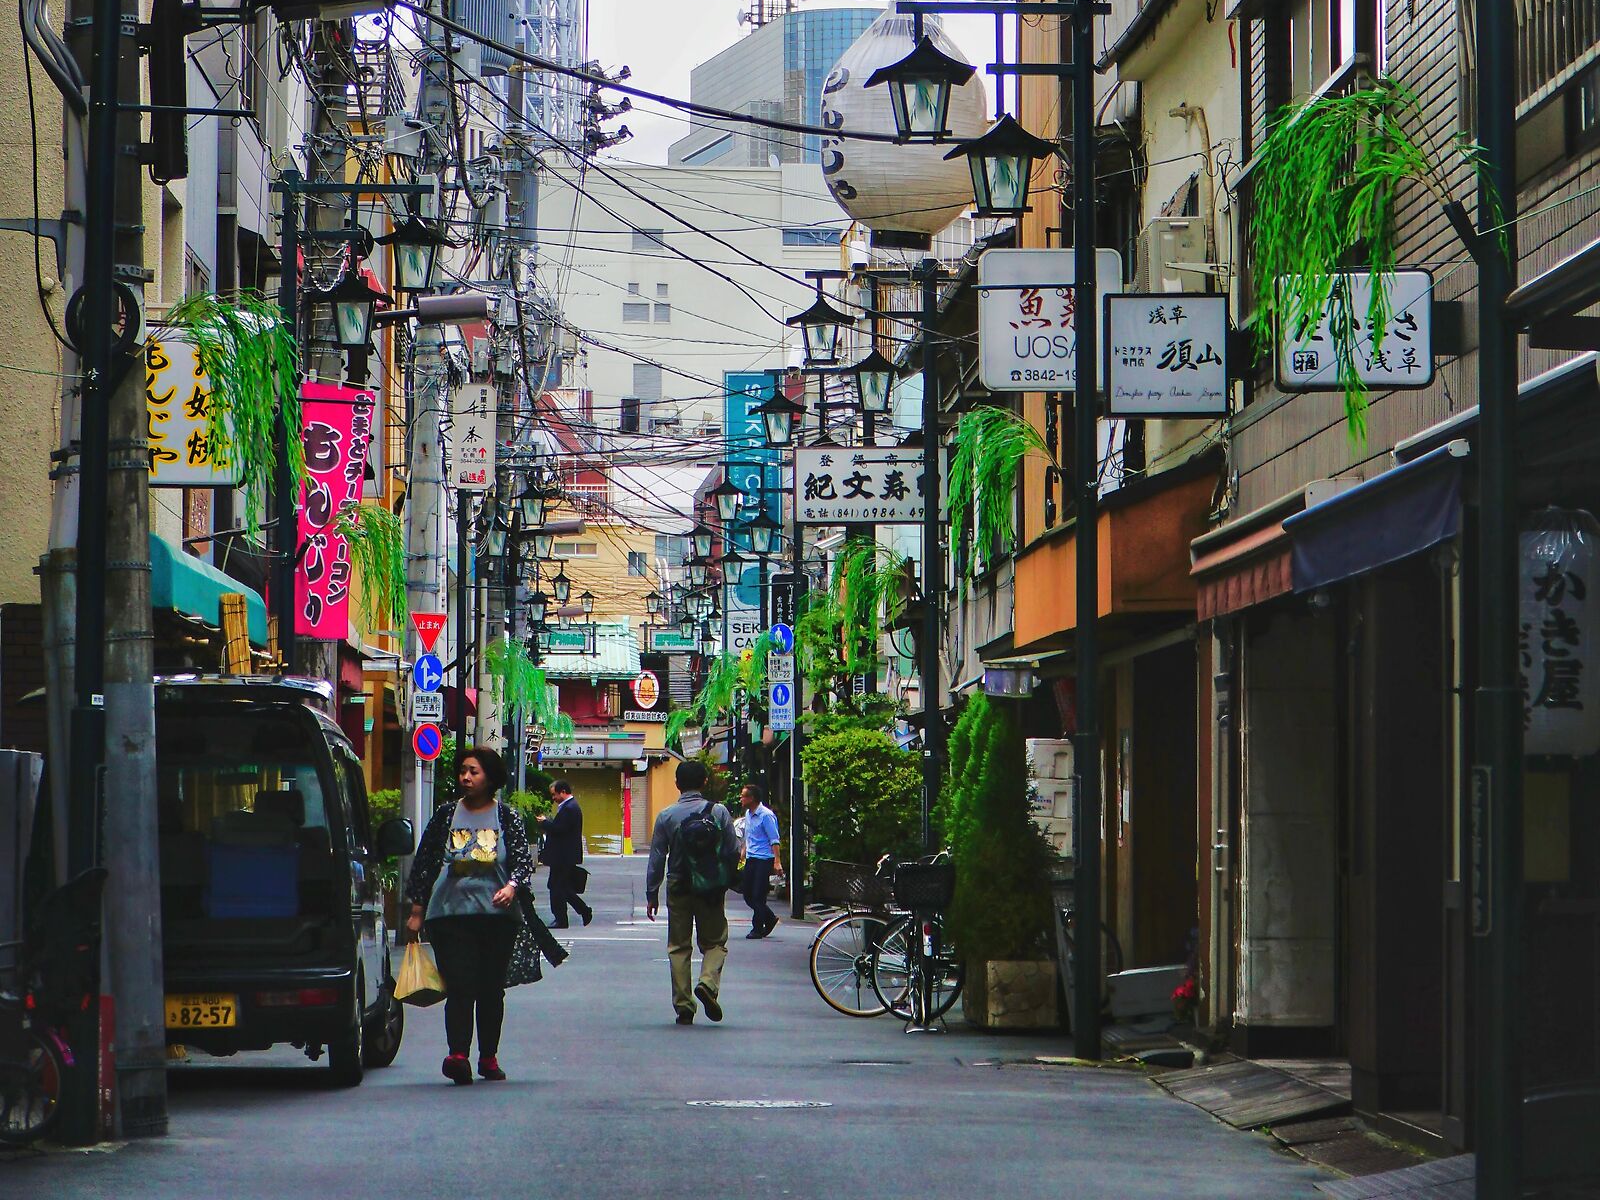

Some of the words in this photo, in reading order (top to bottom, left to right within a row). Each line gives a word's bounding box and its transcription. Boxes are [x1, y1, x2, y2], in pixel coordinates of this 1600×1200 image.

[1149, 306, 1187, 325] 浅草
[1157, 339, 1222, 372] 須山
[1365, 348, 1421, 374] 浅草
[419, 621, 440, 629] 止まれ
[1532, 562, 1586, 710] かき屋
[181, 1006, 231, 1025] 82-57
